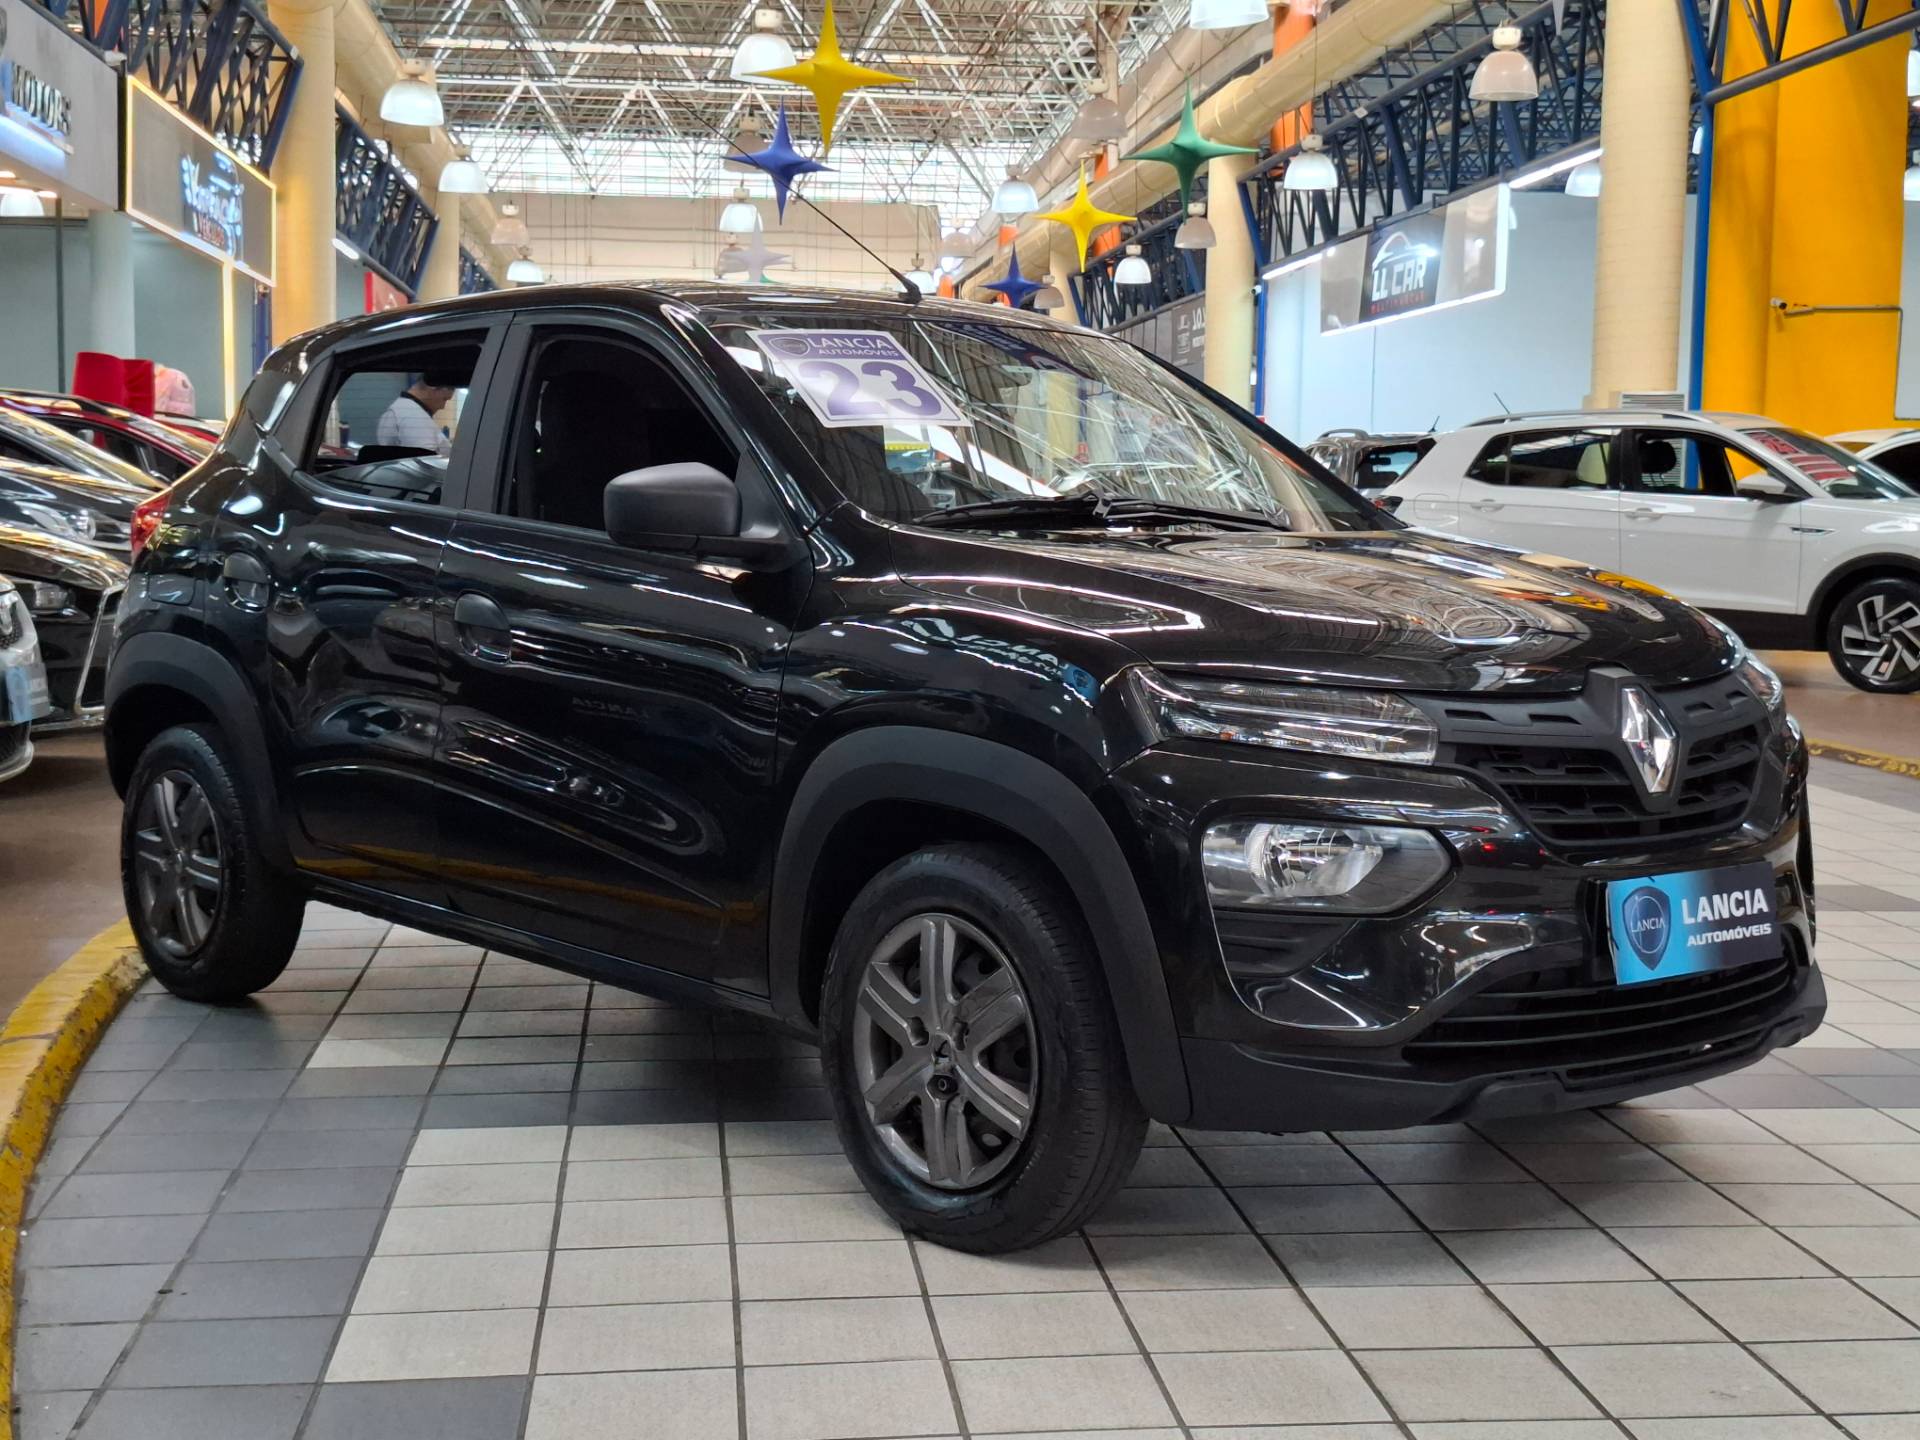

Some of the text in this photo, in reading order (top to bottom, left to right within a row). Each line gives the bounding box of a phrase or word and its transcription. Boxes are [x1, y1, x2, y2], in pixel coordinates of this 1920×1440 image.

[1371, 257, 1428, 302] LL CAR
[806, 336, 893, 350] LANCIA
[798, 360, 942, 416] 23
[1681, 888, 1769, 925] LANCIA
[1631, 916, 1667, 933] LANCIA
[1687, 923, 1772, 947] AUTOMÓVEIS
